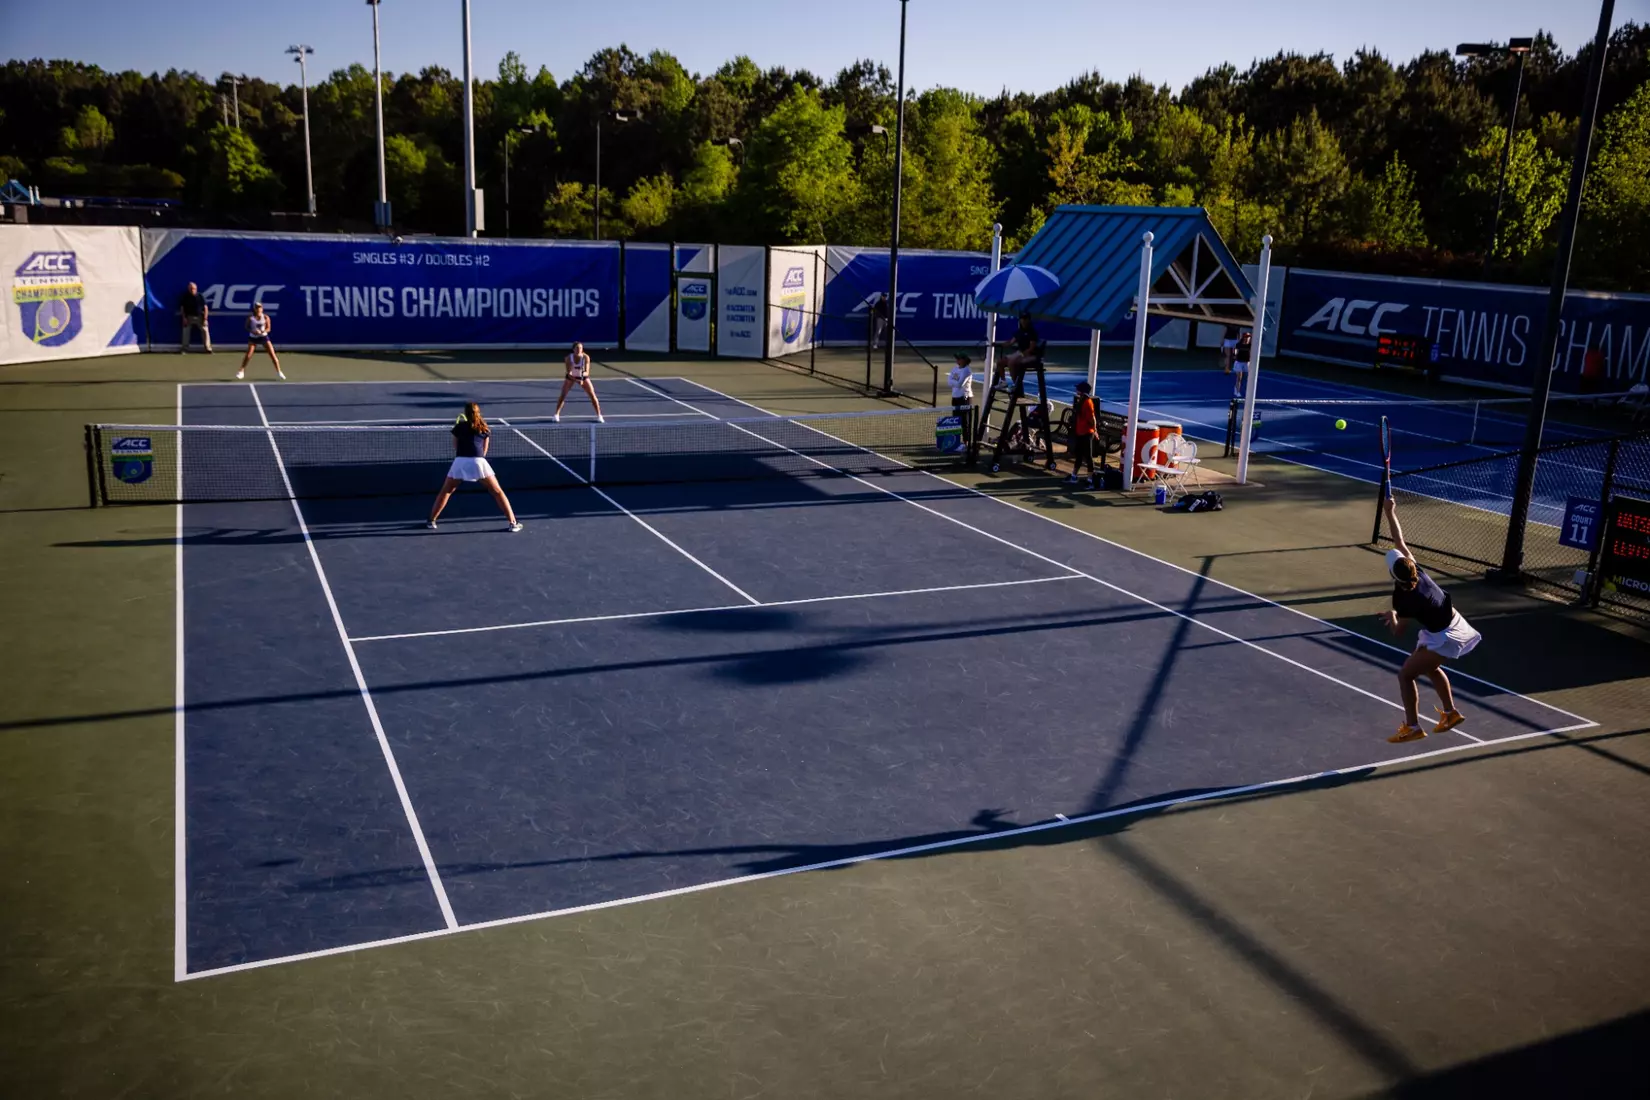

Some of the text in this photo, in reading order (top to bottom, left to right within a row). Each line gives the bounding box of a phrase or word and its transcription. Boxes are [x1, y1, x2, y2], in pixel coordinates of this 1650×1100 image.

[26, 255, 73, 270] ACC
[353, 252, 397, 265] SINGLES
[399, 253, 415, 265] #3
[425, 253, 473, 266] DOUBLES
[475, 255, 490, 267] #2
[786, 270, 803, 282] ACC
[970, 265, 989, 276] SING
[16, 286, 82, 300] CHAMPIONSHIPS
[201, 284, 601, 318] ACC TENNIS CHAMPIONSHIPS
[851, 291, 988, 319] AC TENN
[1301, 297, 1410, 336] ACC
[1421, 306, 1530, 366] TENNIS
[941, 416, 960, 425] ACC
[120, 439, 147, 447] ACC
[1574, 503, 1597, 513] ACC
[1572, 515, 1593, 525] COURT
[1569, 524, 1588, 545] 11
[1612, 574, 1650, 592] MICRO
